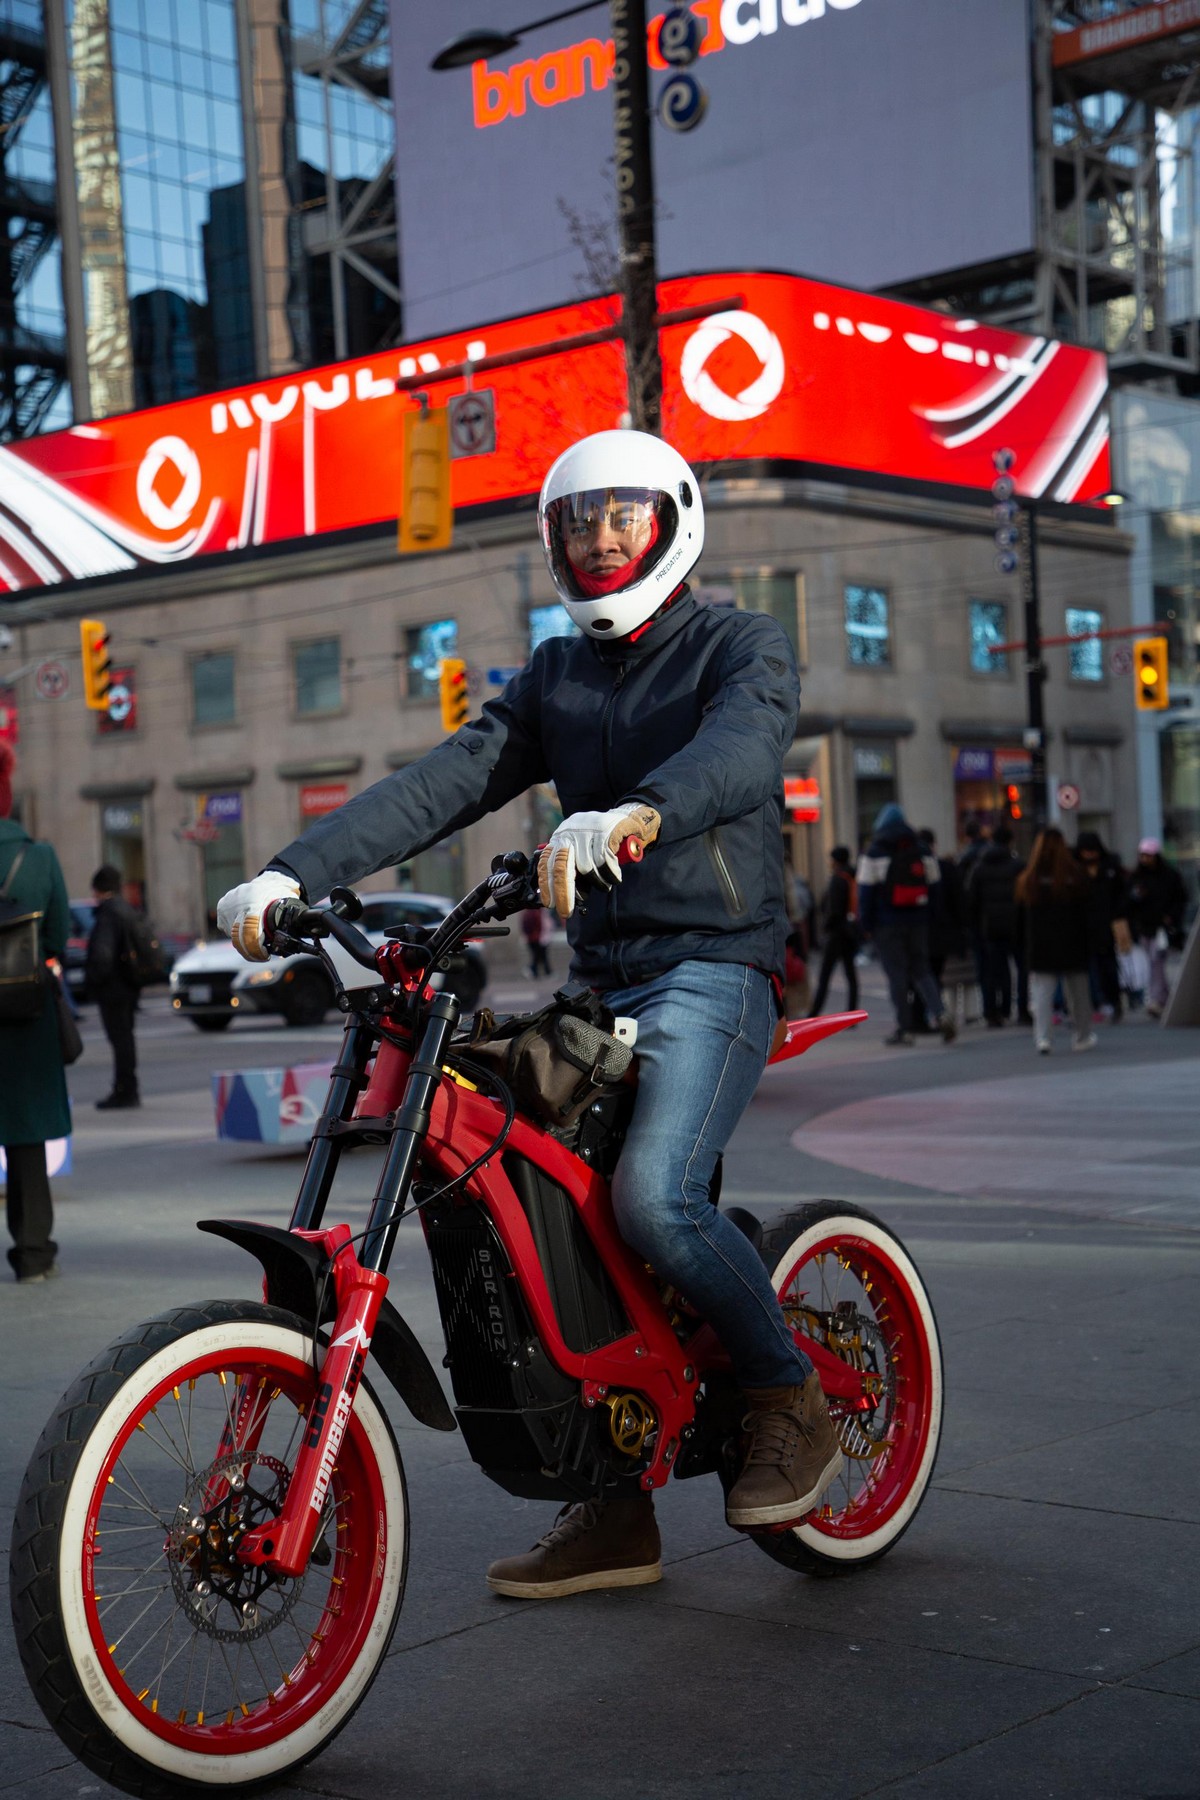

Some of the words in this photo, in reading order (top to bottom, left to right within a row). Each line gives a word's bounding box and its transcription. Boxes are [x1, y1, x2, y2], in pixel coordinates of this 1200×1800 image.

[655, 548, 683, 582] PREDATOR
[479, 1250, 506, 1350] SUR-RON
[309, 1390, 353, 1514] BOMBER
